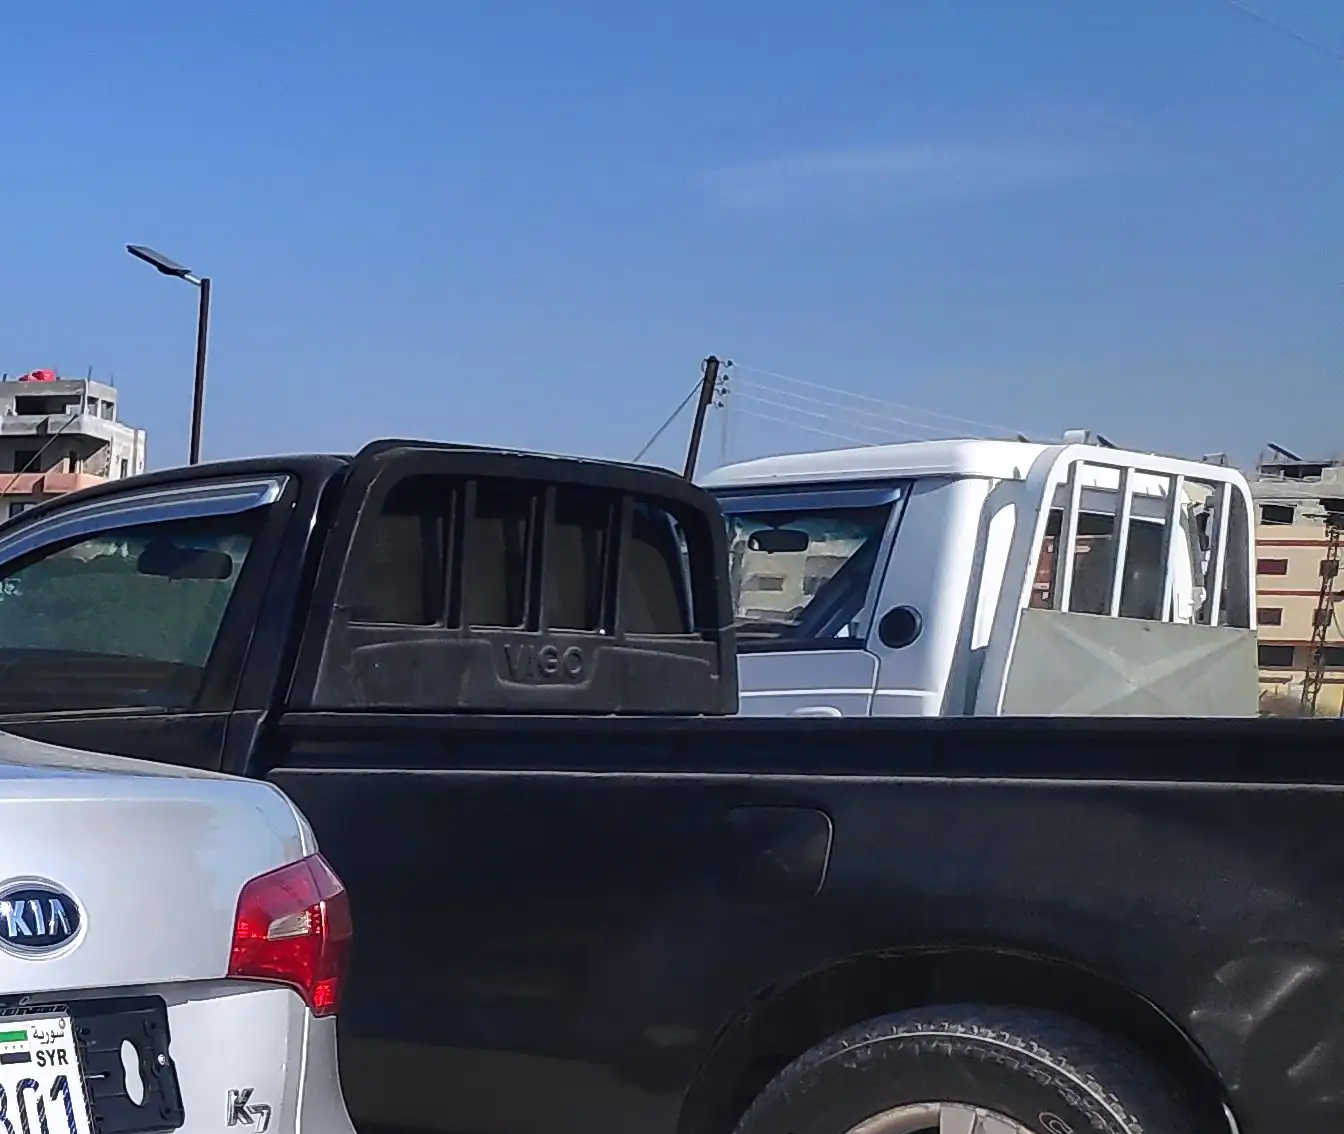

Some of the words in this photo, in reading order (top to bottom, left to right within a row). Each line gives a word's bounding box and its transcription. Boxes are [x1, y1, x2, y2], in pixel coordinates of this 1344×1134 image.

[503, 643, 583, 680] VIGO
[0, 898, 72, 937] KIA
[31, 1025, 65, 1045] سورية
[36, 1048, 69, 1068] SYR
